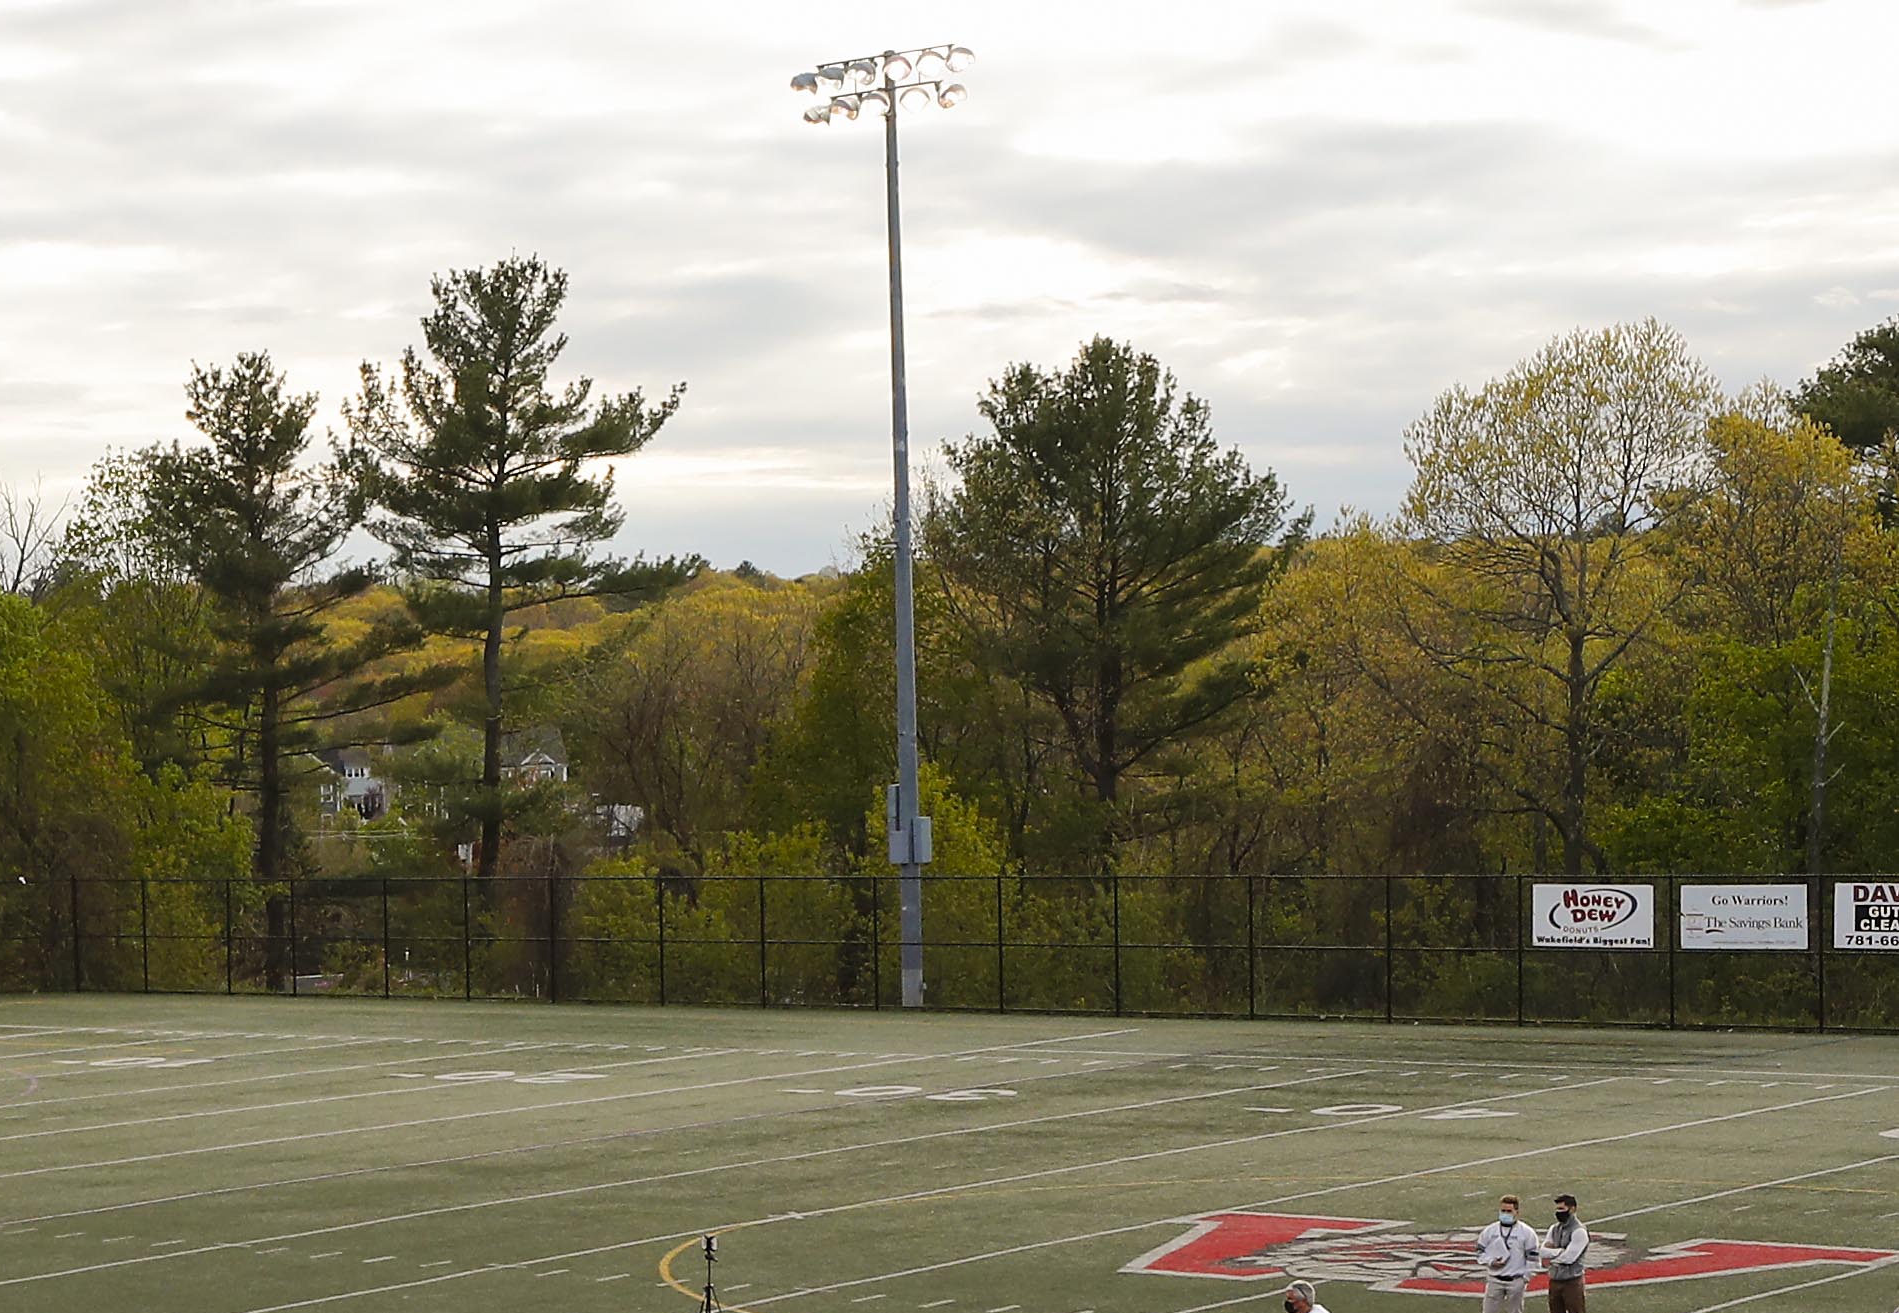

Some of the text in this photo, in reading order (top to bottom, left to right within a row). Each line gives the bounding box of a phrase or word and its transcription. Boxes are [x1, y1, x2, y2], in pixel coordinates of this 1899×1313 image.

[1563, 889, 1625, 909] HONEY
[1853, 885, 1899, 903] DAV
[1711, 895, 1789, 906] Go Warriors!
[1571, 909, 1617, 923] DEW
[1868, 906, 1899, 918] GUT
[1704, 916, 1803, 930] The Savings Bank
[1860, 919, 1899, 931] CLEA
[1563, 926, 1599, 934] DONUTS
[1536, 935, 1651, 947] Wakefield's Biggest Fan!
[1845, 935, 1899, 946] 781-66
